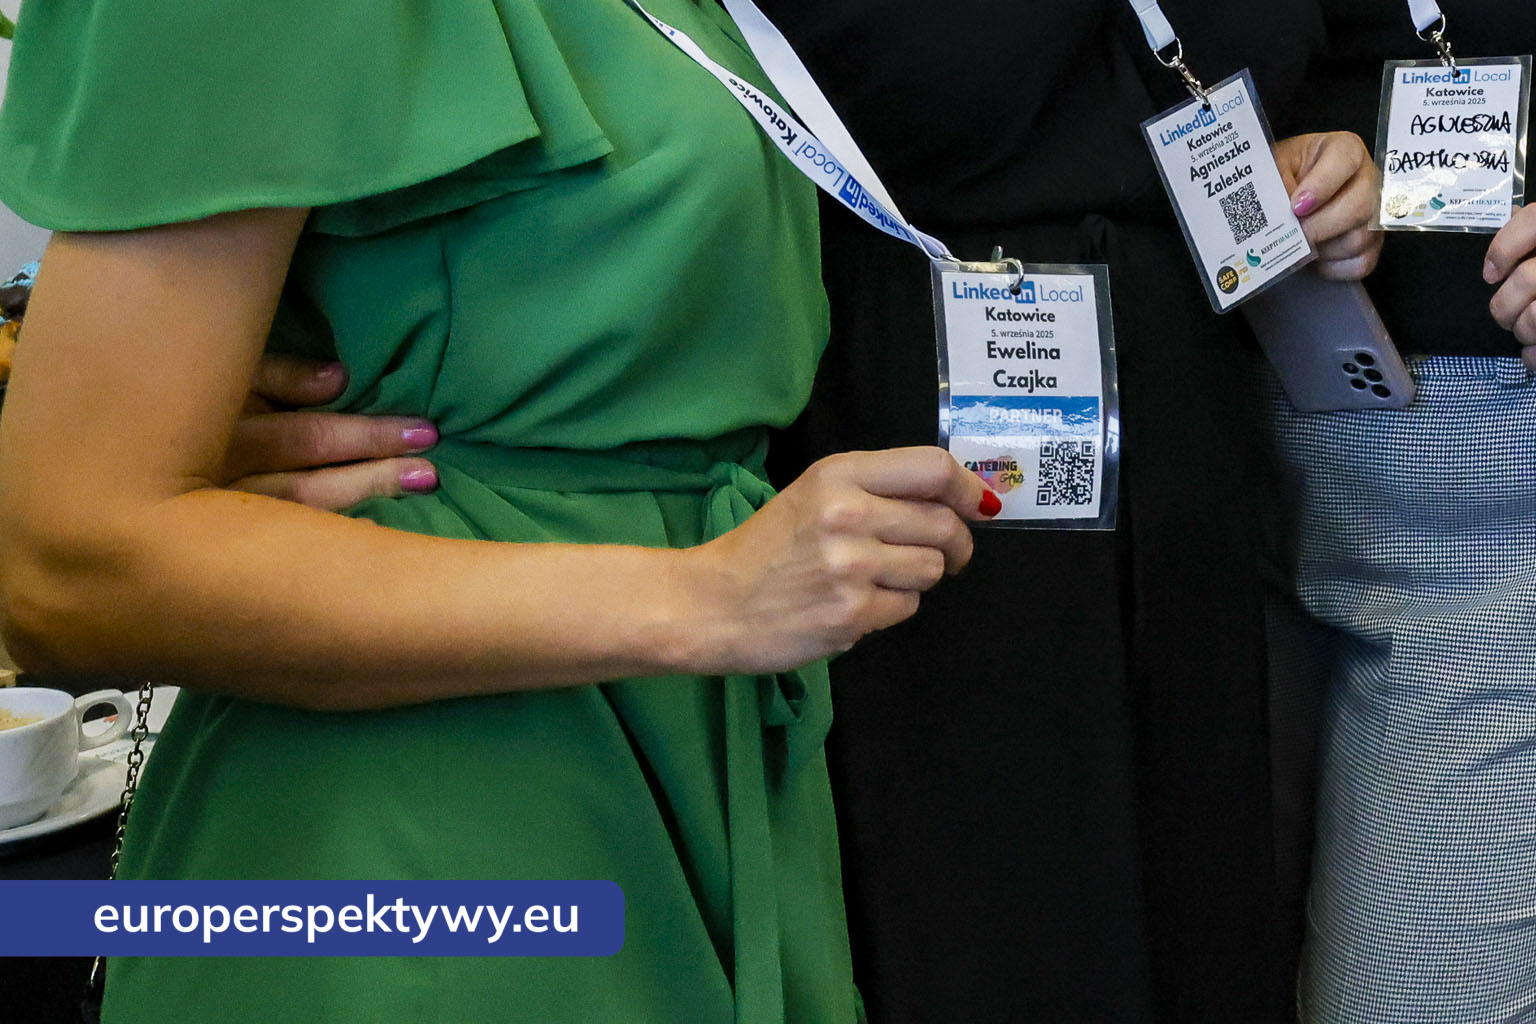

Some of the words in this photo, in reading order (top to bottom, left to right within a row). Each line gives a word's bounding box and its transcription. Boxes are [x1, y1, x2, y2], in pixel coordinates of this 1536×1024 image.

[1474, 69, 1511, 82] Local
[1426, 86, 1484, 97] Katowice
[1431, 98, 1466, 106] września
[1467, 97, 1487, 105] 2025
[728, 77, 798, 146] Katowice
[1215, 90, 1245, 116] Local
[1186, 121, 1233, 152] Katowice
[1191, 155, 1199, 163] 5.
[1198, 141, 1225, 158] września
[1225, 131, 1240, 144] 2025
[791, 140, 846, 188] Local
[1190, 140, 1251, 182] Agnieszka
[1203, 164, 1253, 198] Zaleska
[1040, 284, 1084, 302] Local
[985, 306, 1056, 322] Katowice
[991, 329, 998, 337] 5.
[1000, 328, 1035, 338] września
[1036, 330, 1054, 338] 2025
[986, 340, 1061, 360] Ewelina
[992, 369, 1058, 393] Czajka
[964, 460, 1018, 472] CATERING
